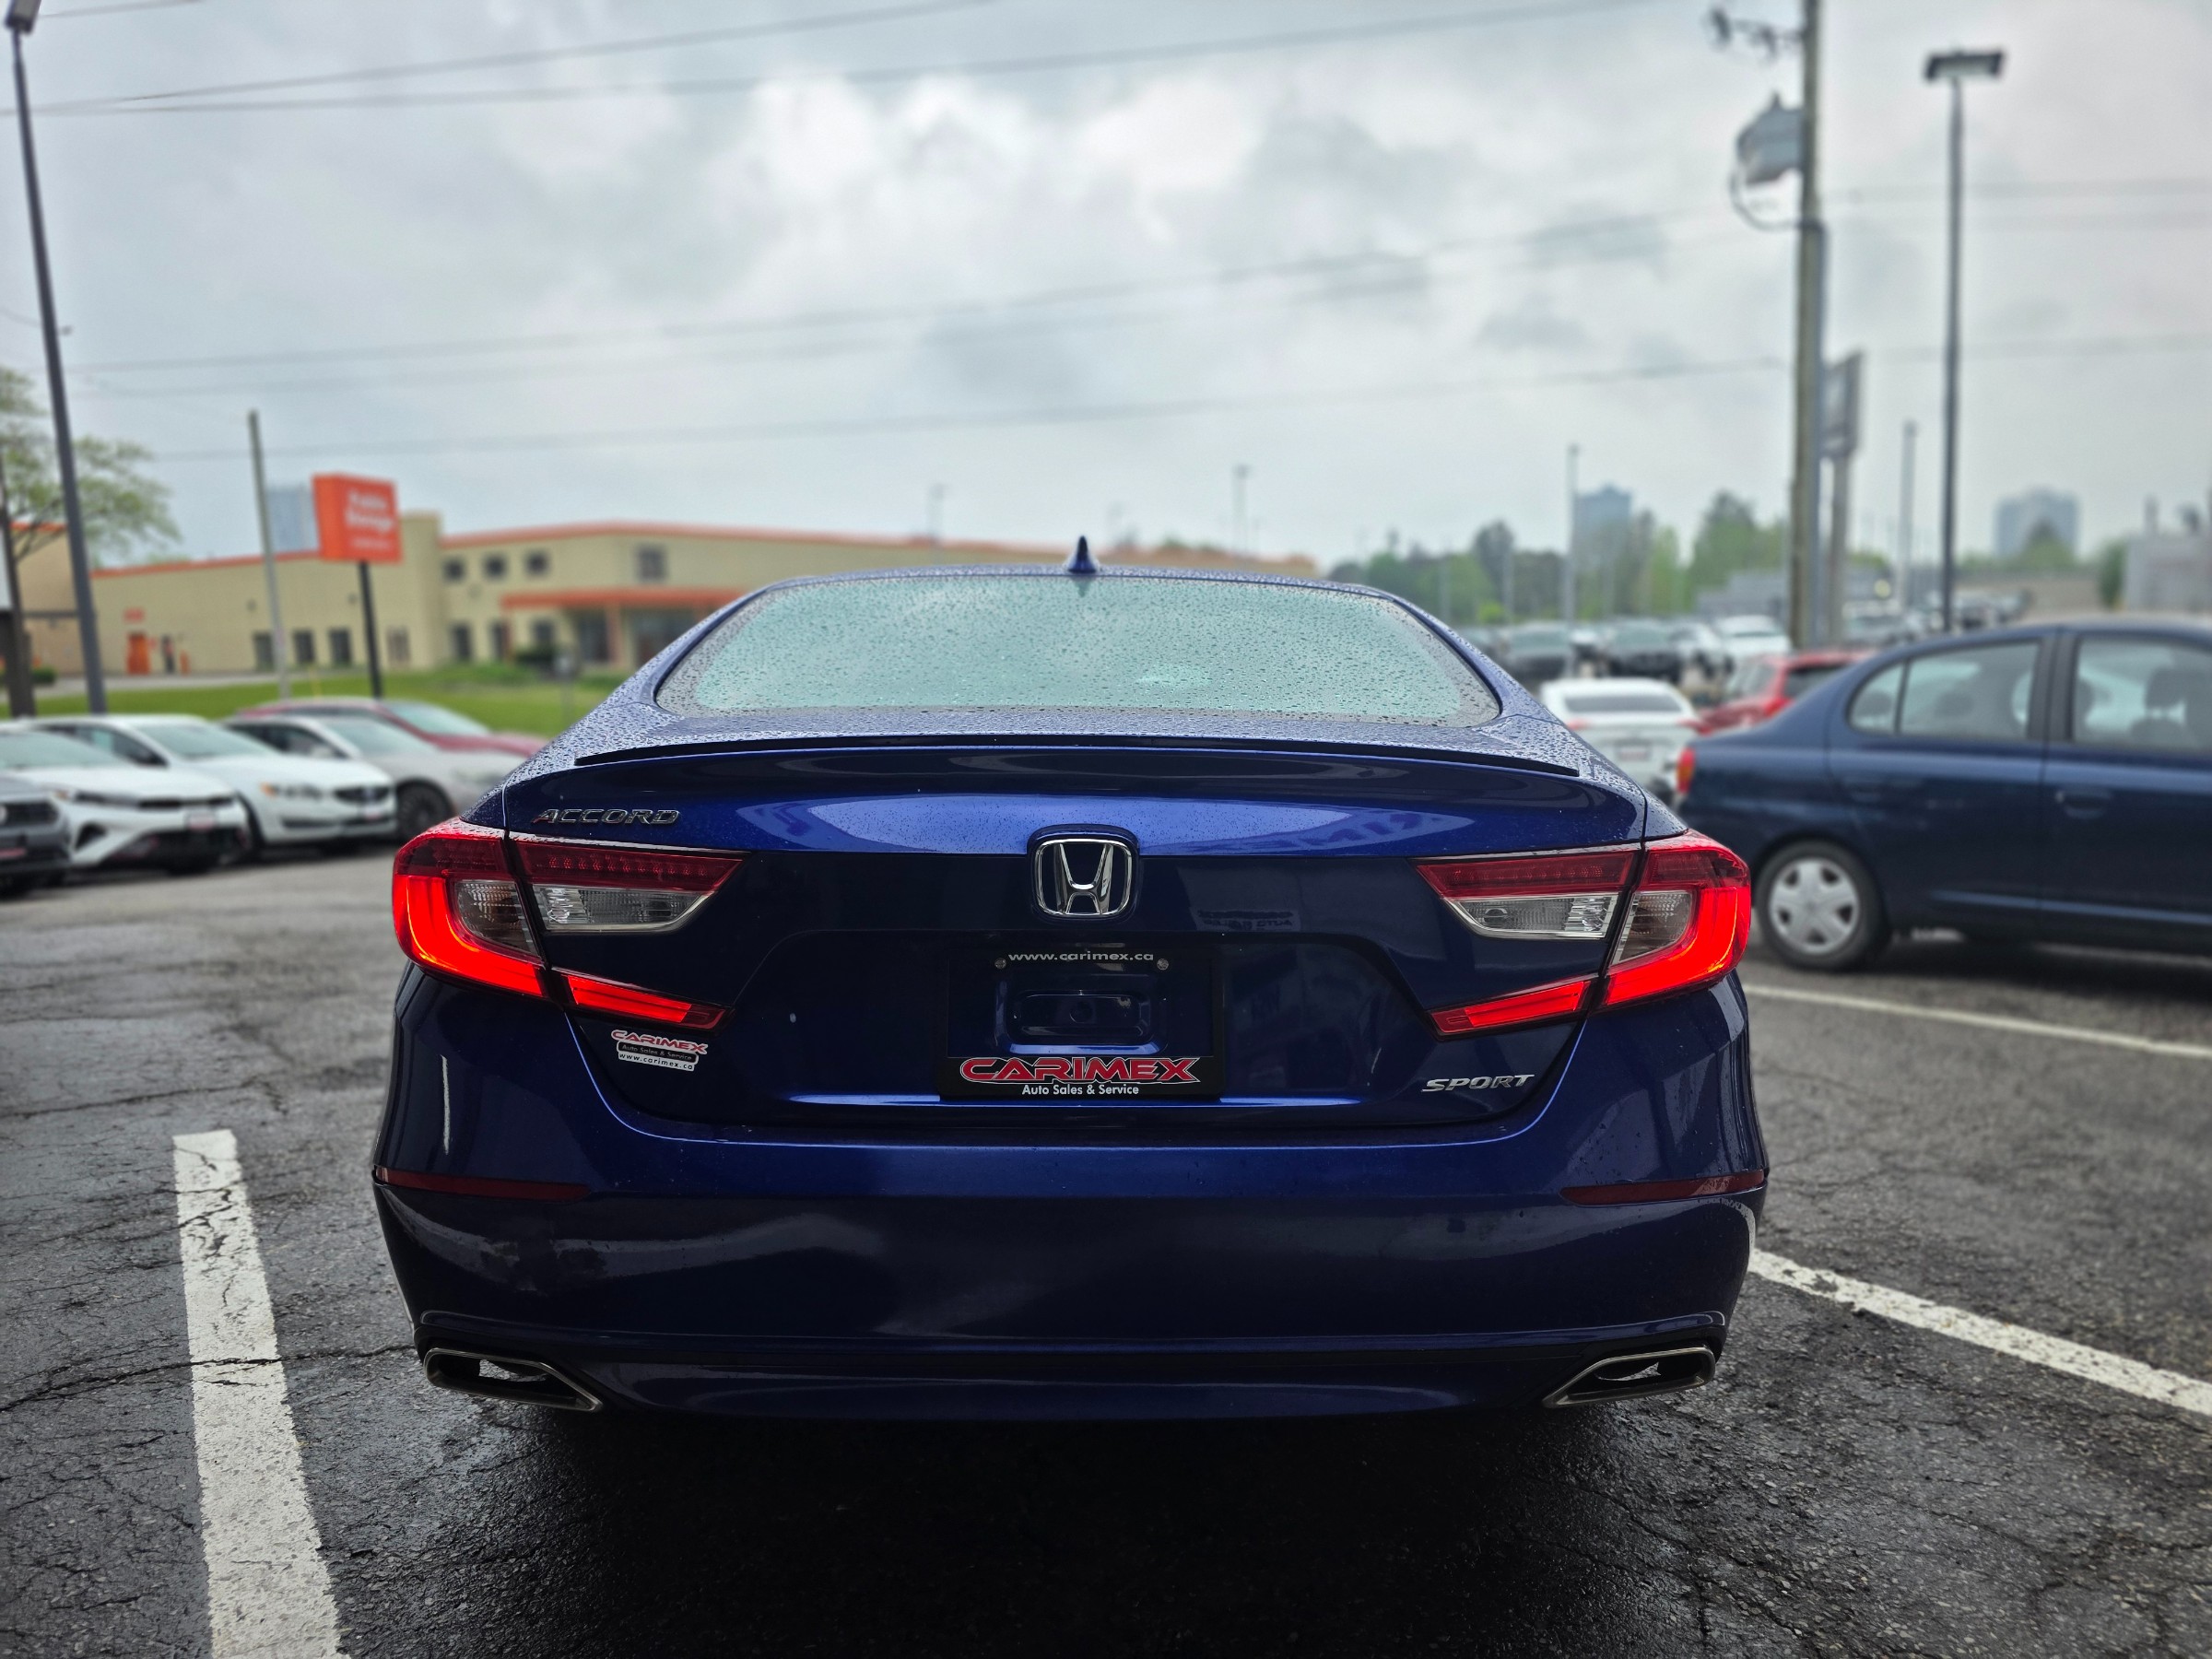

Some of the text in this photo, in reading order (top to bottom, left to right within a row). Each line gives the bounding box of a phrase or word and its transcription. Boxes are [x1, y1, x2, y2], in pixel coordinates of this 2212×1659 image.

[532, 808, 680, 825] ACCORD
[1008, 950, 1154, 961] www.carimex.ca
[611, 1030, 708, 1055] CARIMEX
[621, 1043, 639, 1052] Auto
[640, 1046, 658, 1055] Sales
[960, 1057, 1200, 1083] CARIMEX
[1021, 1083, 1139, 1095] Auto Sales & Service
[1420, 1074, 1535, 1093] SPORT
